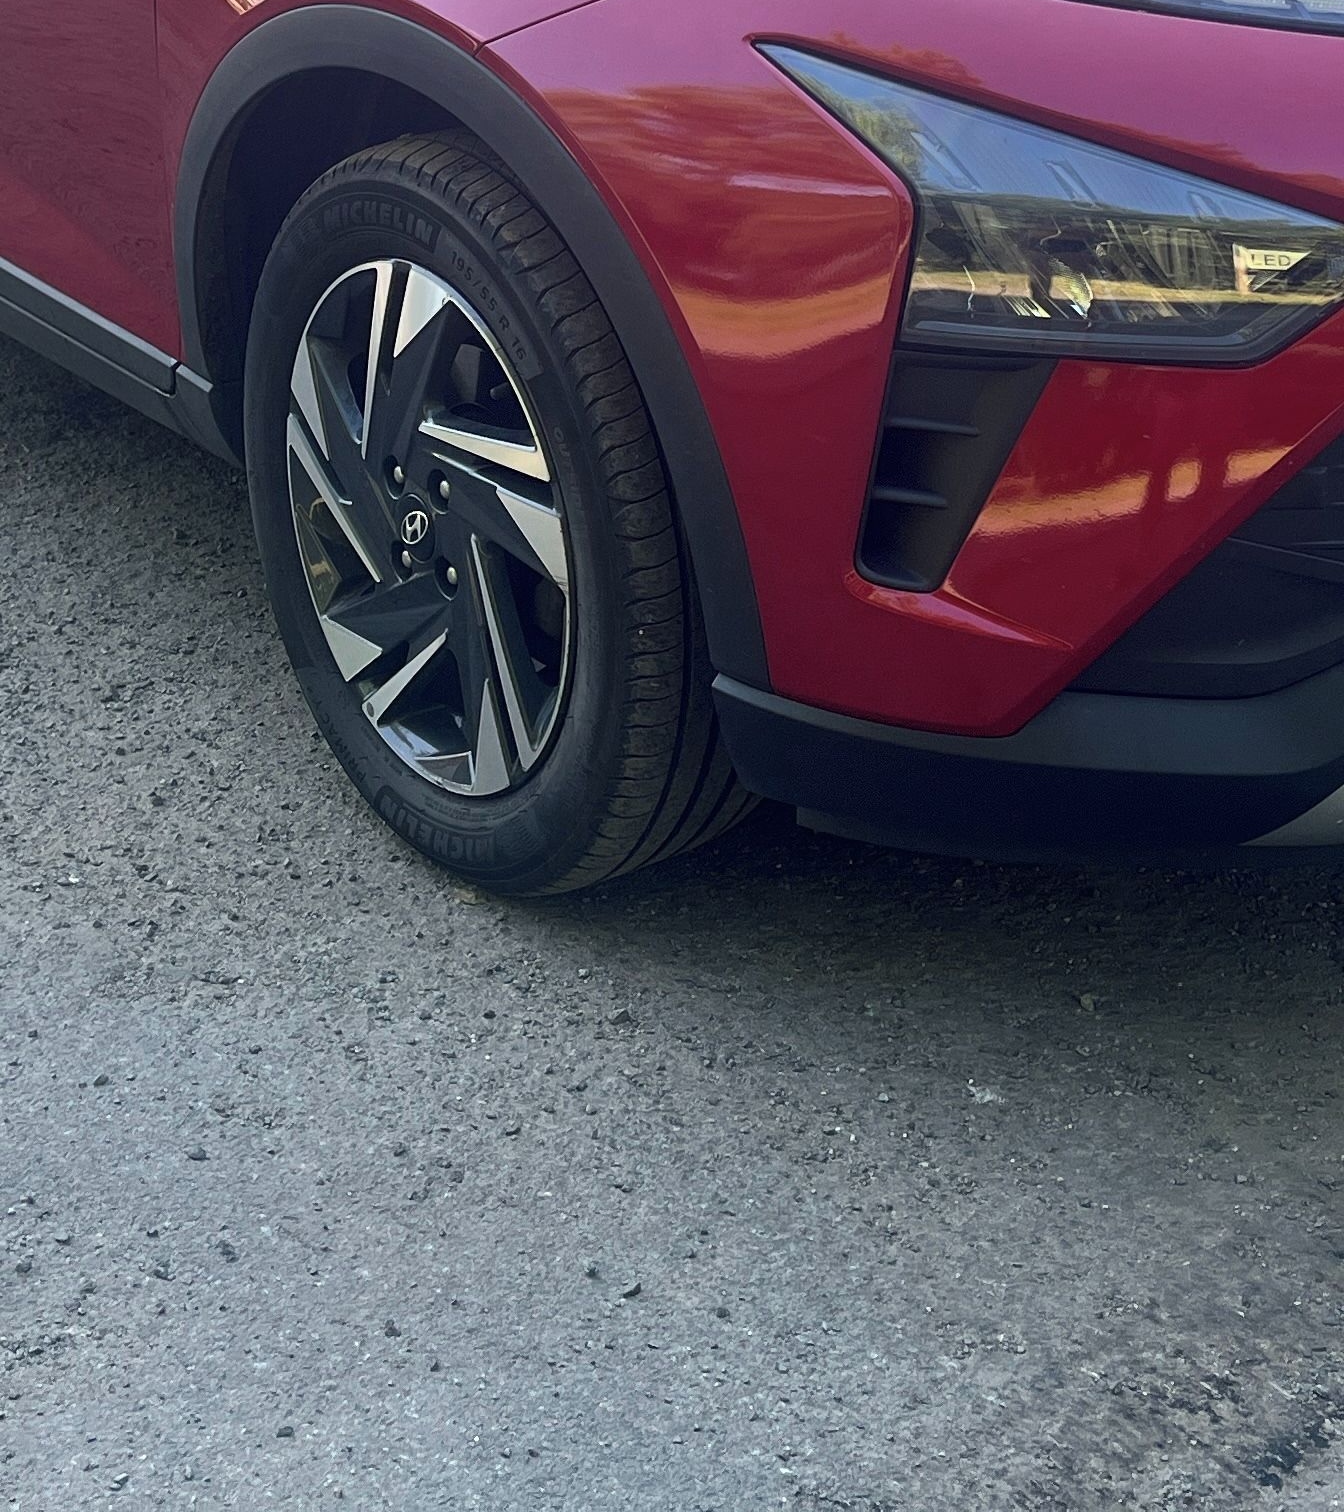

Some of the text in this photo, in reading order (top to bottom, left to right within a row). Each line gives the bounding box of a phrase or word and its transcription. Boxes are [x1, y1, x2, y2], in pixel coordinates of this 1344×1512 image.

[323, 200, 433, 247] MICHELIN
[1250, 253, 1291, 267] LED
[450, 250, 528, 361] 195/55 R 16
[379, 789, 497, 862] MICHELIN
